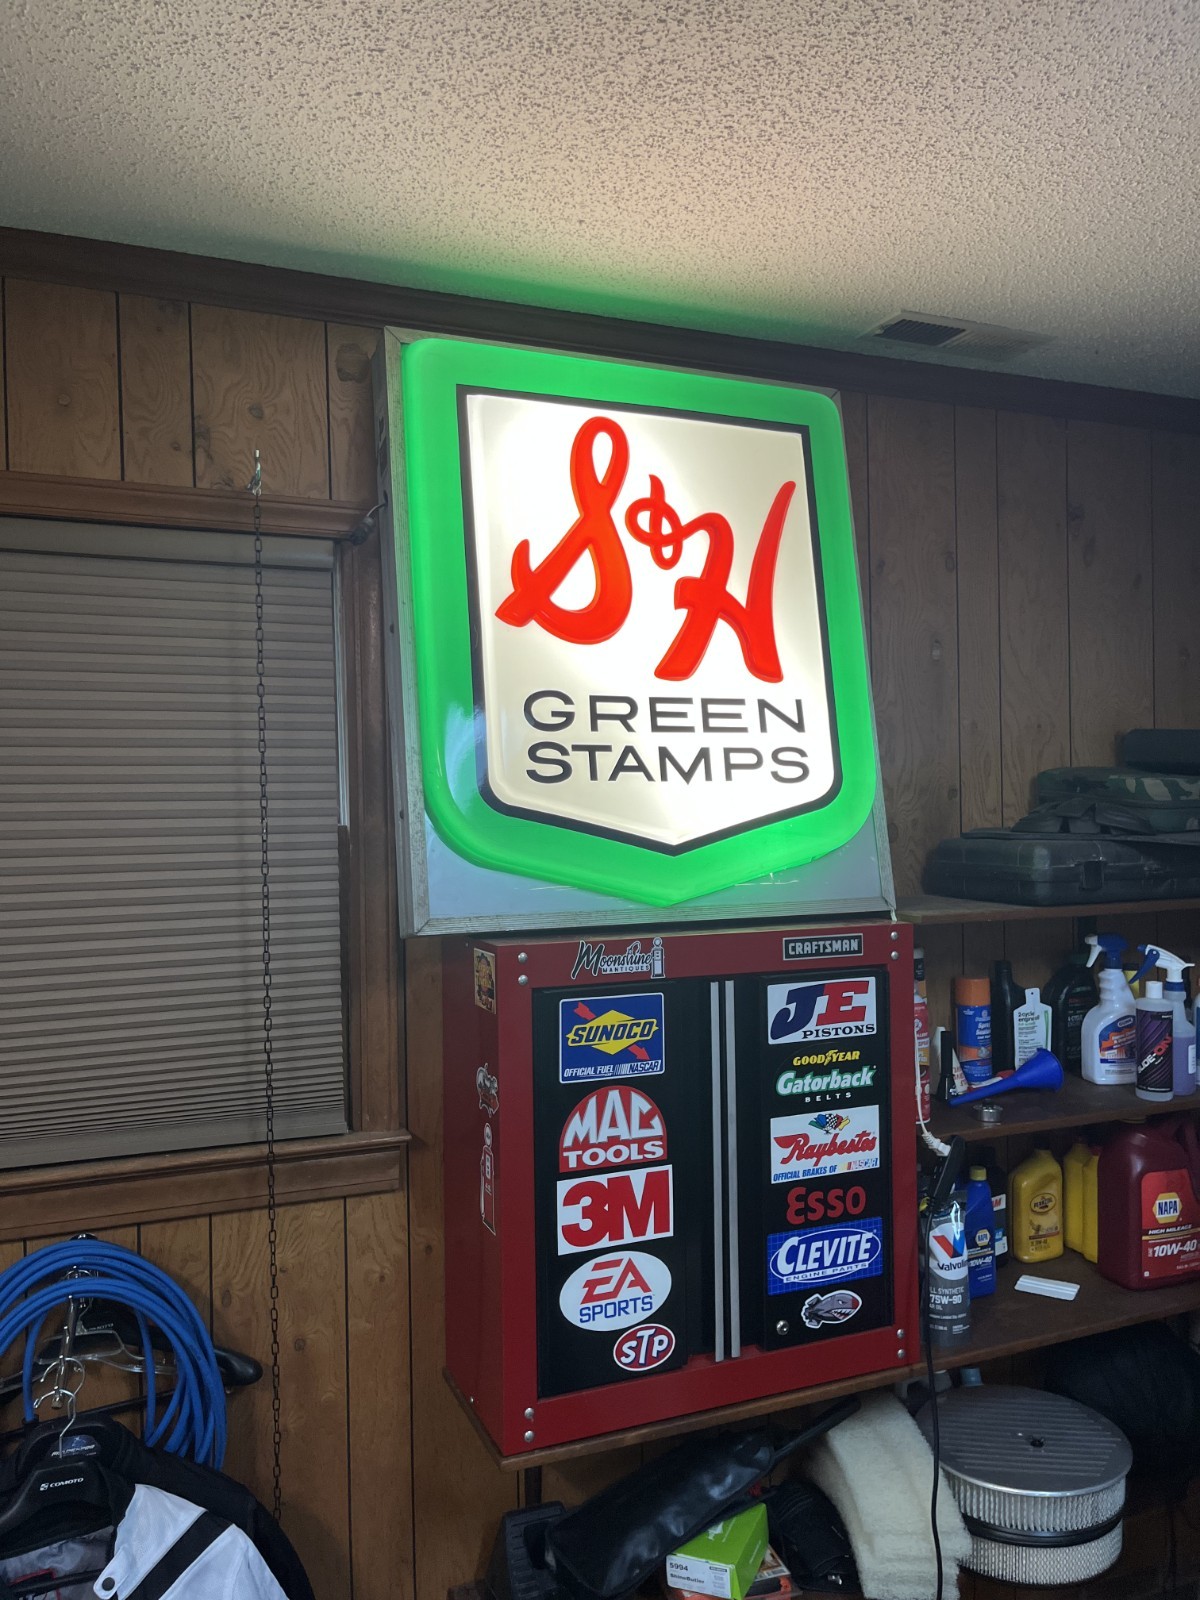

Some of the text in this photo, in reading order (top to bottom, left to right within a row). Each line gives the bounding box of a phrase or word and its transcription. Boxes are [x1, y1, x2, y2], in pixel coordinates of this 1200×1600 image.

[523, 690, 806, 733] GREEN
[526, 741, 810, 785] STAMPS
[788, 939, 859, 955] CRAFTSMAN
[571, 940, 652, 979] Moonshine
[602, 965, 650, 973] MANTIQUES
[770, 981, 869, 1040] JE
[571, 1021, 655, 1044] SUNOCO
[801, 1024, 875, 1039] PISTONS
[564, 1060, 661, 1077] OFFICIAL FUEL NASCAR
[776, 1066, 877, 1096] Gatorback
[805, 1092, 851, 1102] BELTS
[563, 1141, 664, 1168] TOOLS
[773, 1130, 877, 1167] Raybestos
[773, 1171, 800, 1182] OFFICIAL
[802, 1166, 827, 1177] BRAKES
[829, 1165, 837, 1173] OF
[561, 1170, 670, 1247] 3M
[1158, 1200, 1178, 1215] NAPA
[1166, 1224, 1192, 1232] MILEAGE
[777, 1233, 873, 1274] CLEVITE
[1154, 1239, 1197, 1257] 10W-40
[580, 1257, 652, 1305] EA
[786, 1263, 867, 1281] ENGINE PARTS
[579, 1295, 653, 1323] SPORTS
[930, 1294, 962, 1304] 75W-90
[620, 1328, 668, 1364] STP
[50, 1478, 84, 1487] COMOTO
[669, 1562, 689, 1571] 5994
